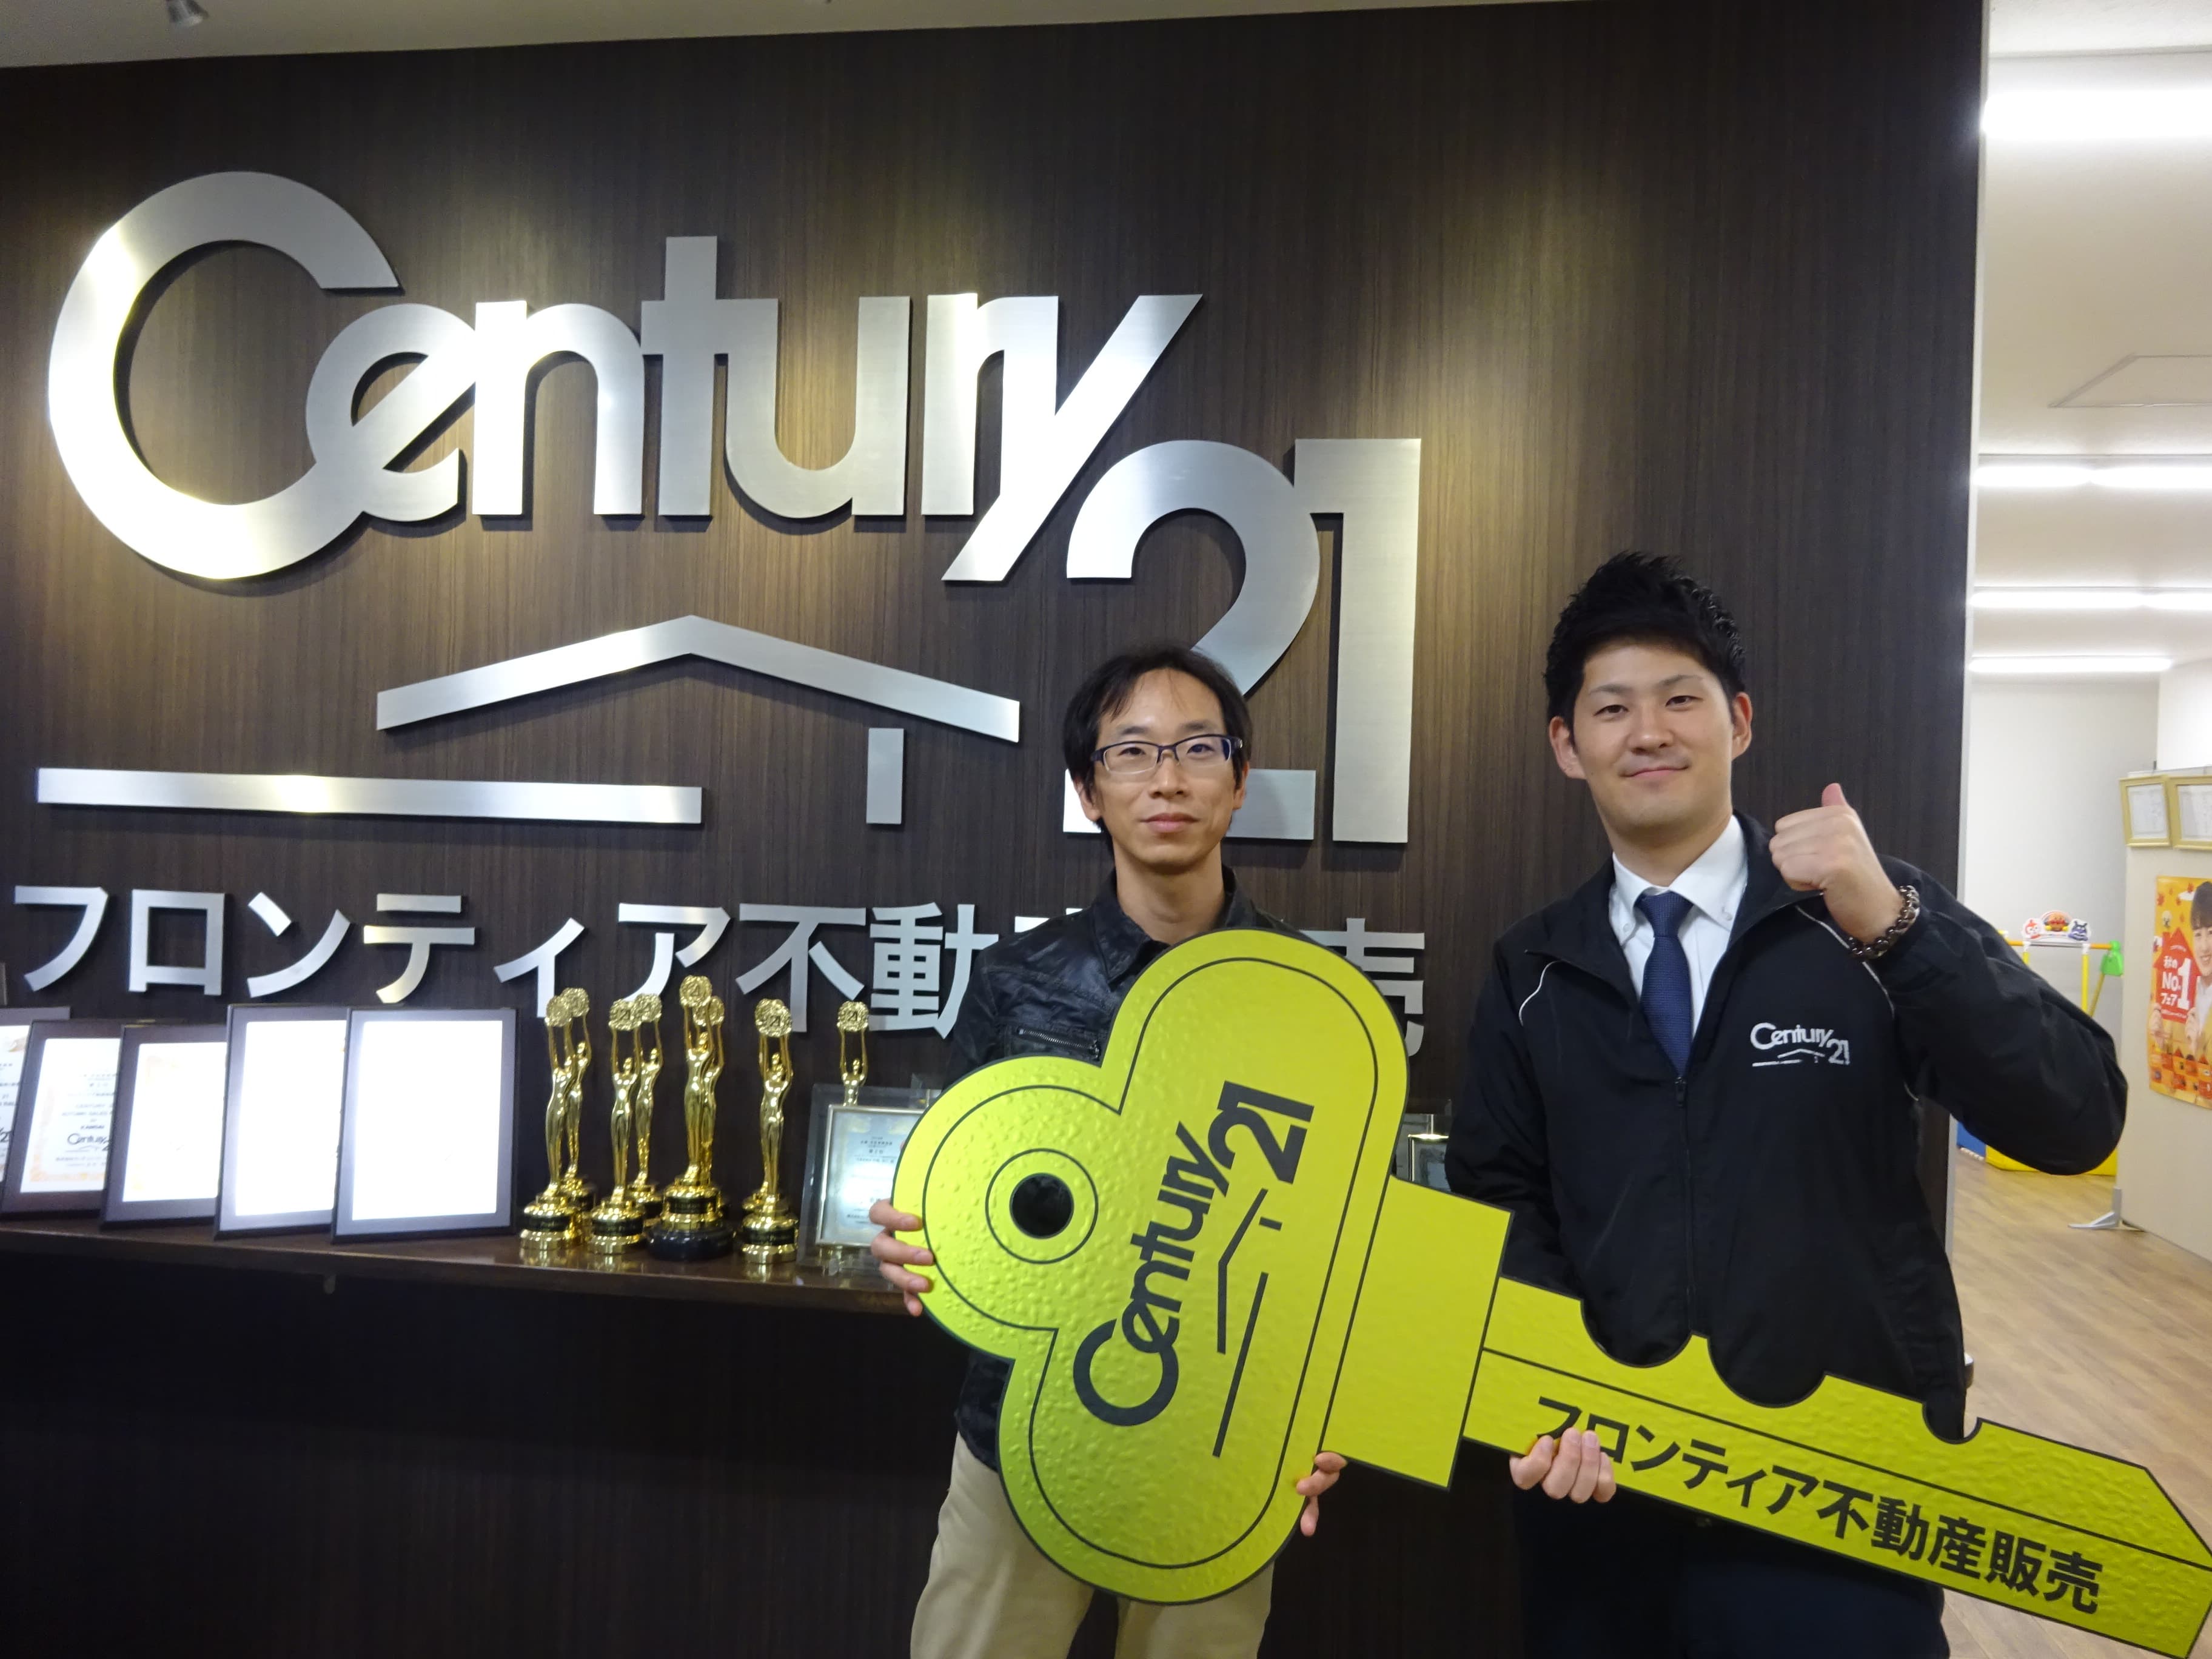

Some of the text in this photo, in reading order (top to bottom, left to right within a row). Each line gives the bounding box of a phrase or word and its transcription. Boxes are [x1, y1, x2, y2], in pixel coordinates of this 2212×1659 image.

[49, 170, 1422, 843] Century 21
[1750, 1022, 1850, 1065] Century 21
[1073, 1080, 1315, 1426] Century 21
[1537, 1396, 2105, 1615] フロンティア不動産販売
